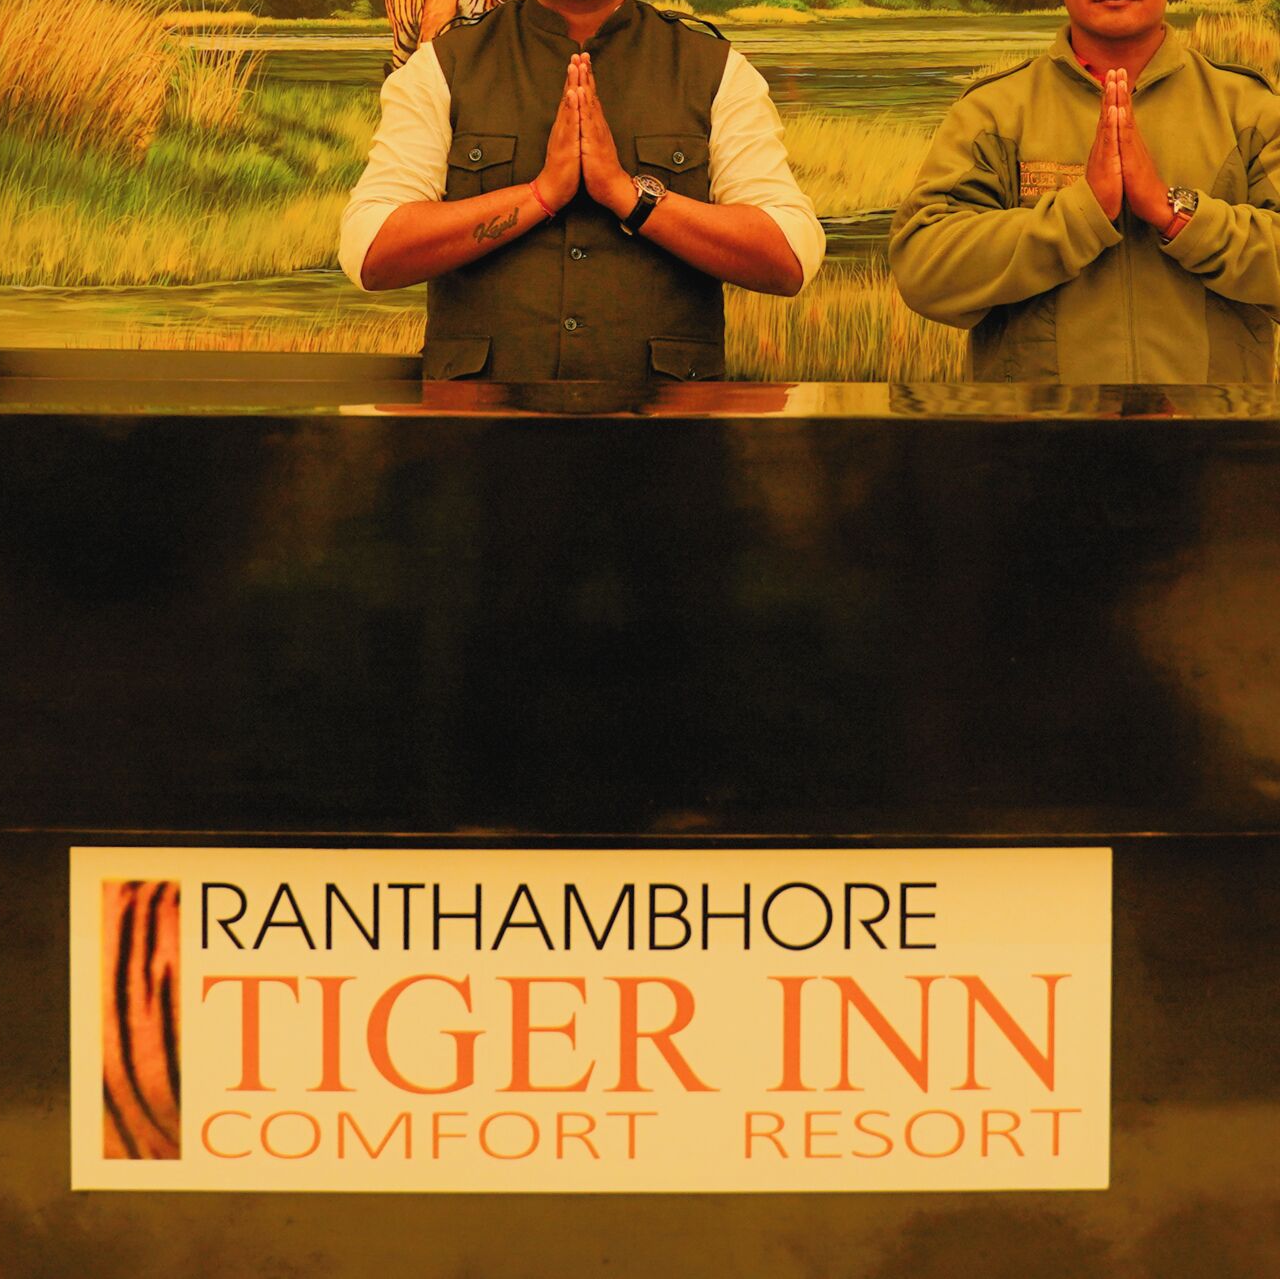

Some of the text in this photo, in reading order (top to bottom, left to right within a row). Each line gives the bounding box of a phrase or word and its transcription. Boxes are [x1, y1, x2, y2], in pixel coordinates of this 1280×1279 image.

[201, 881, 938, 952] RANTHAMBHORE
[201, 974, 1071, 1095] TIGER INN
[201, 1108, 1082, 1160] COMFORT RESORT
